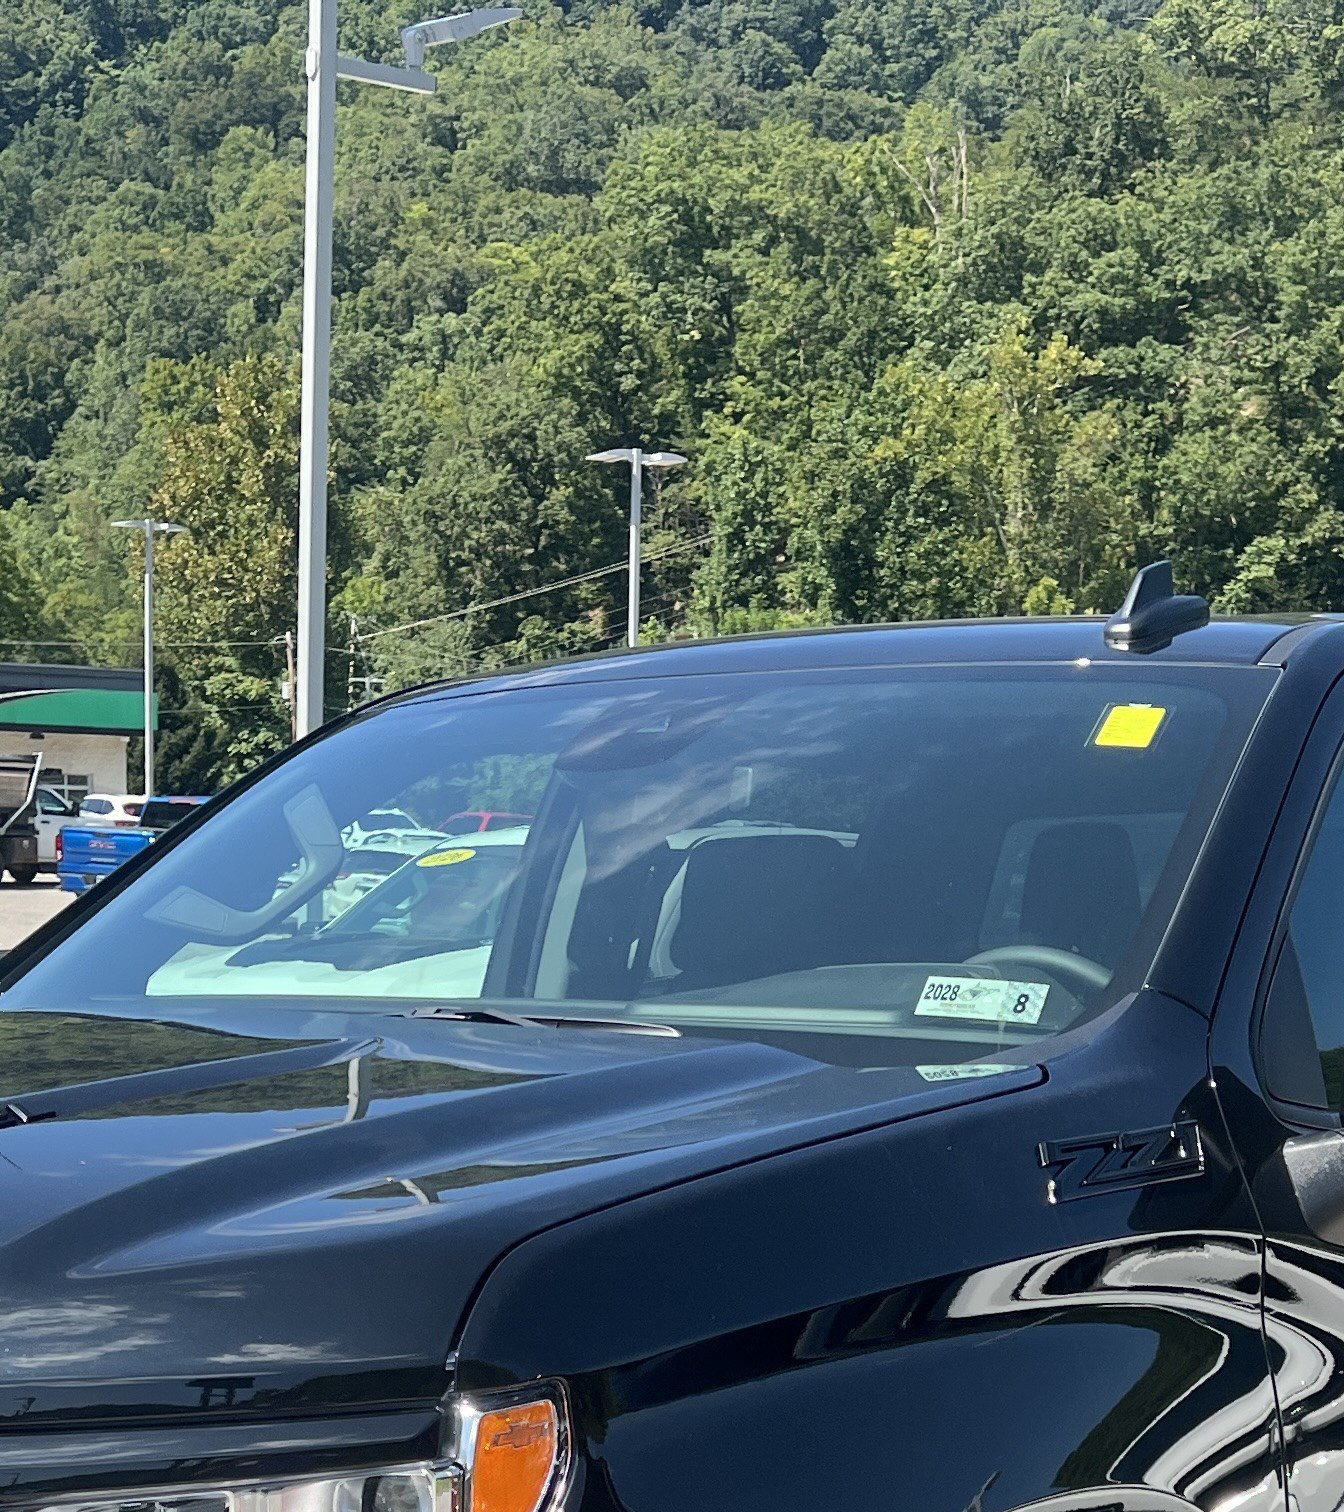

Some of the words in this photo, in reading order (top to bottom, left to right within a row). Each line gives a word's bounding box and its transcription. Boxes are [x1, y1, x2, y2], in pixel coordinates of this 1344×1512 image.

[924, 983, 961, 1001] 2028
[1012, 993, 1030, 1013] 8
[1038, 1120, 1204, 1205] Z71
